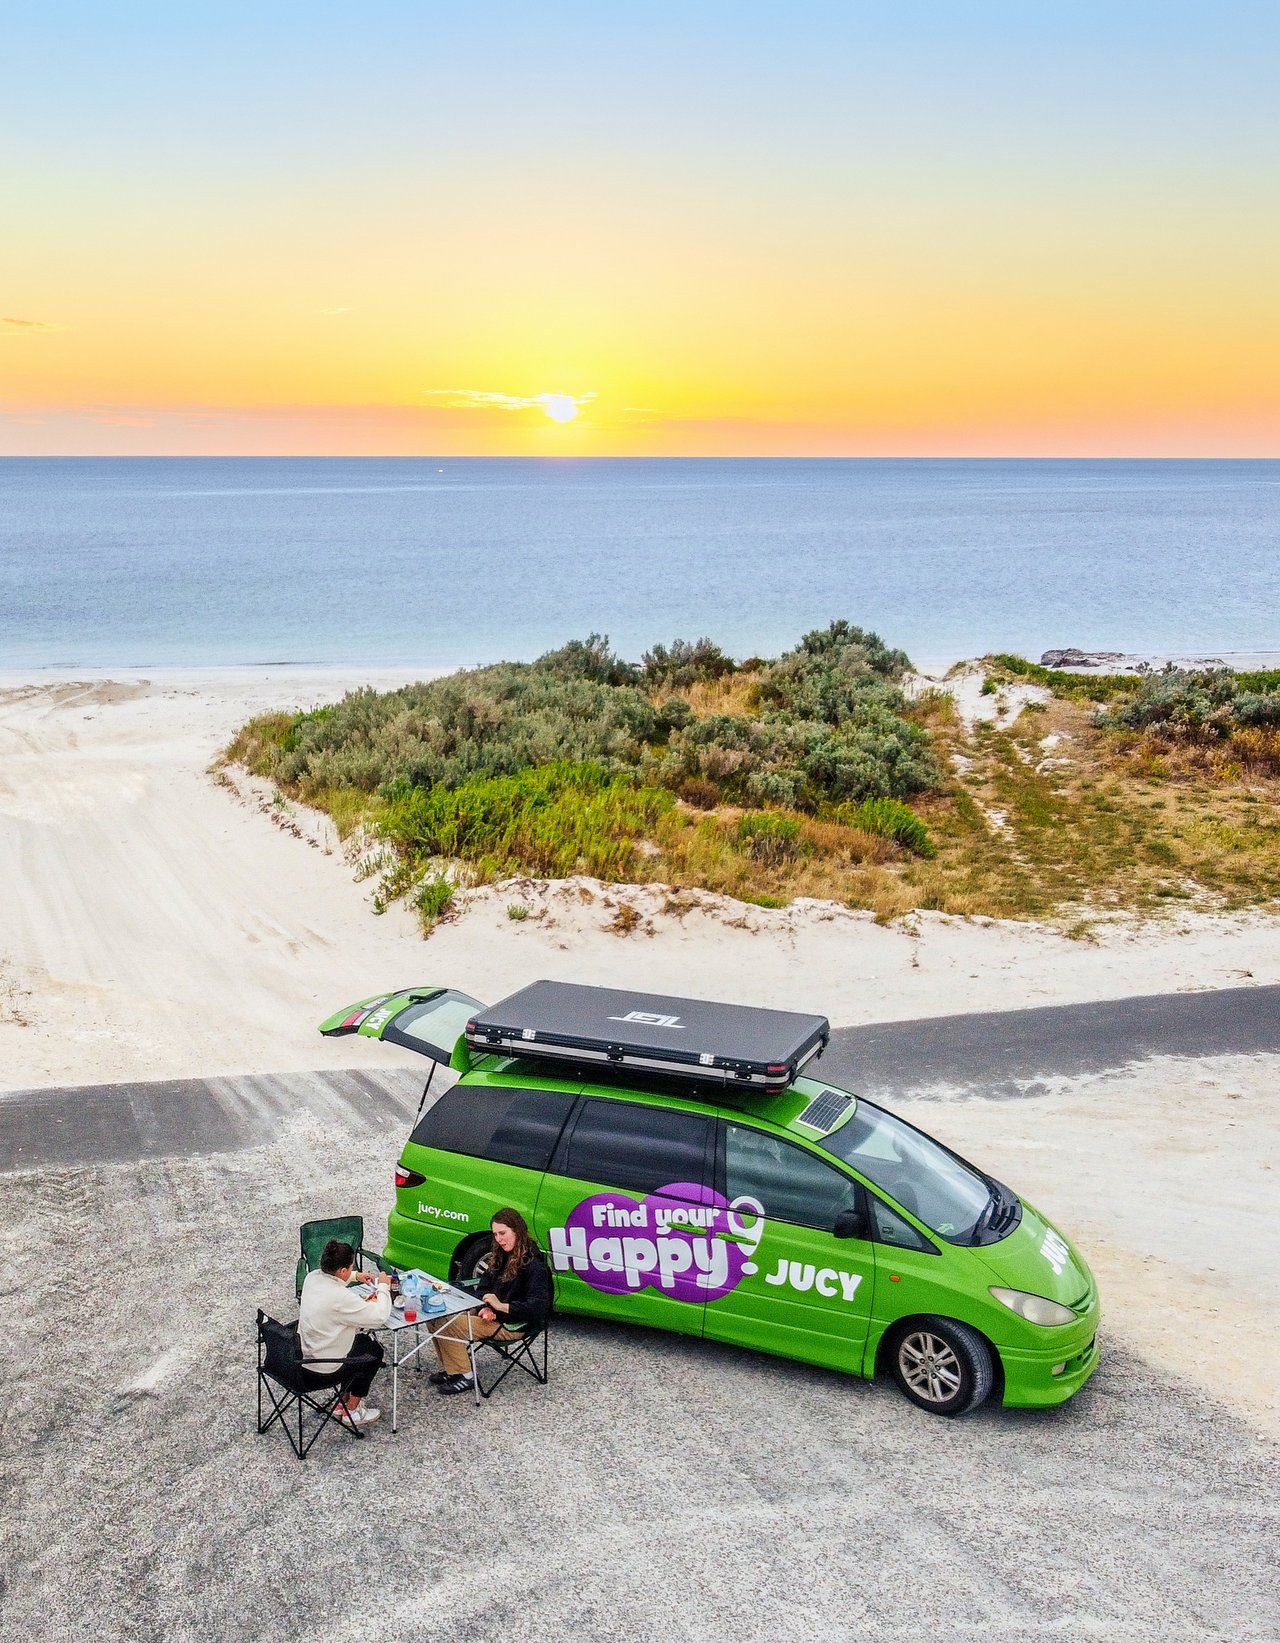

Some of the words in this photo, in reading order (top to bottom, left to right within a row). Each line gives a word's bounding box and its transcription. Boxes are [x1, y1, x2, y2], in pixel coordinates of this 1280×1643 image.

[417, 1201, 469, 1222] jucy.com
[591, 1203, 647, 1227] Find
[654, 1207, 720, 1234] your
[765, 1258, 863, 1302] JUCY
